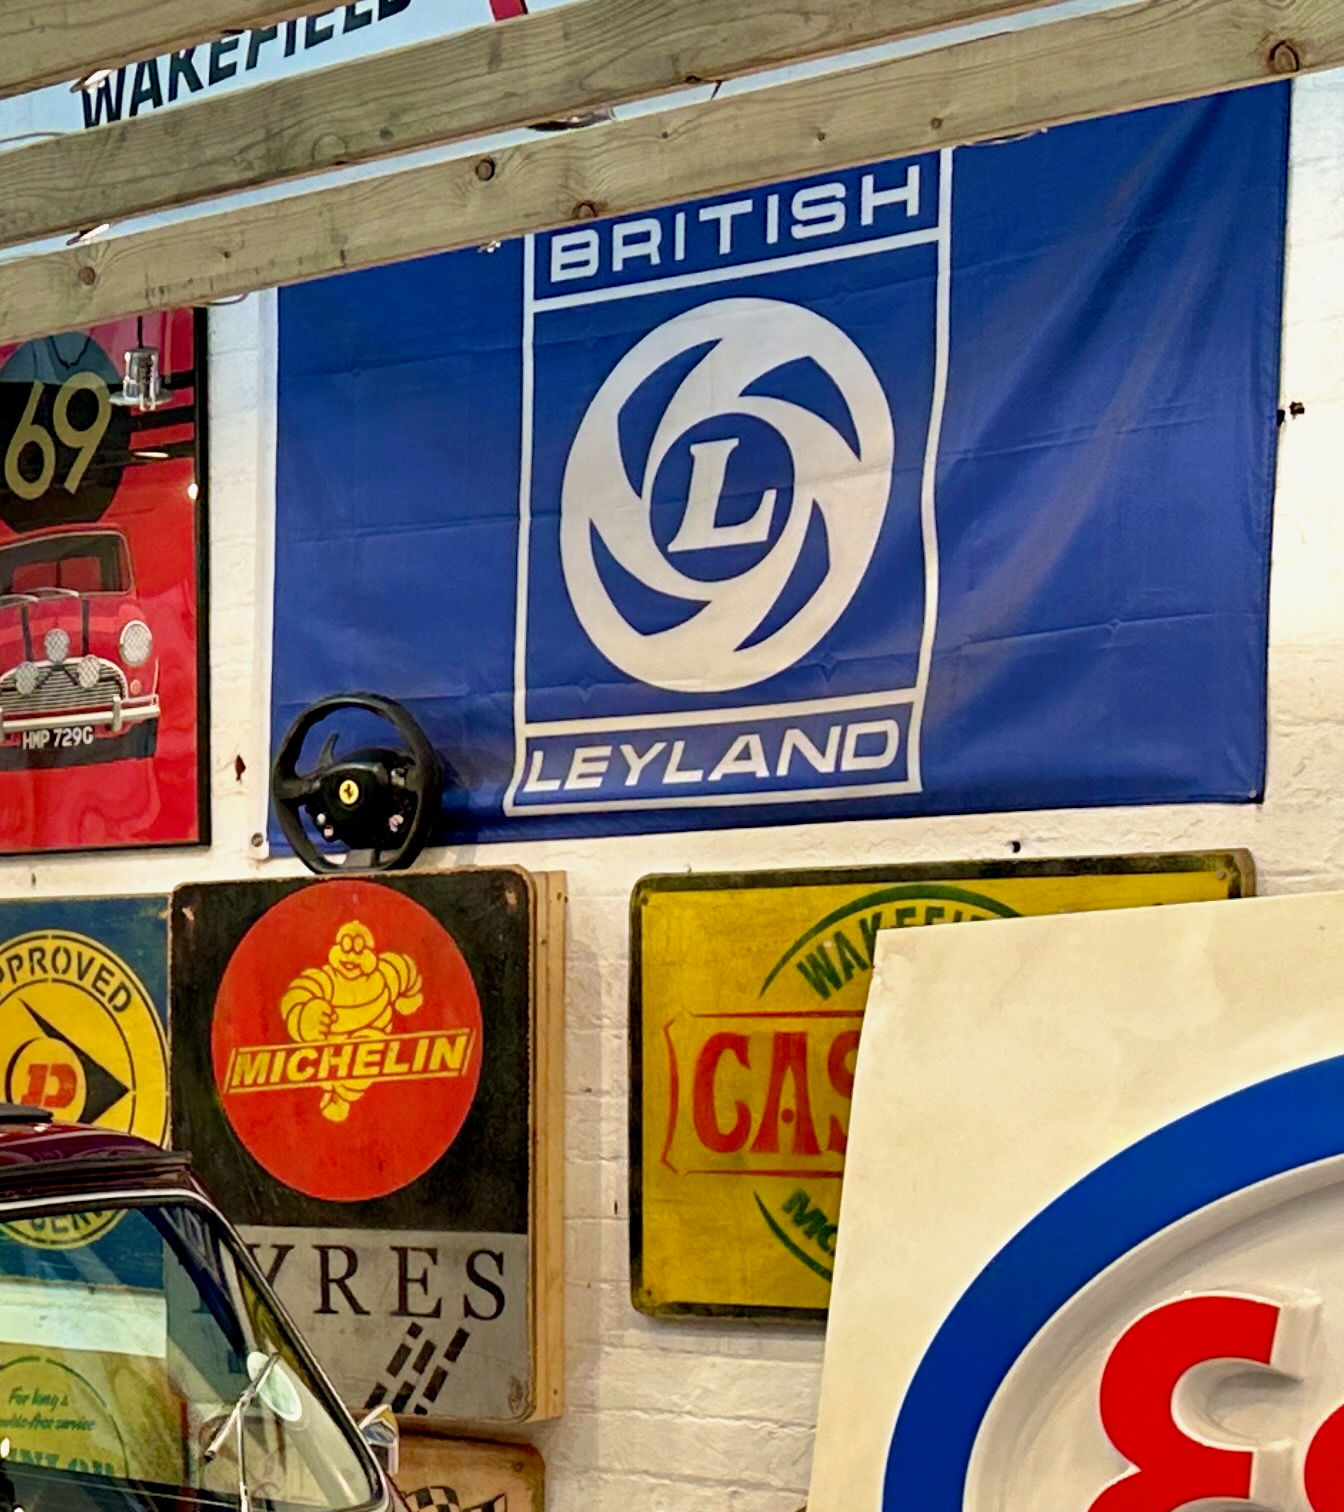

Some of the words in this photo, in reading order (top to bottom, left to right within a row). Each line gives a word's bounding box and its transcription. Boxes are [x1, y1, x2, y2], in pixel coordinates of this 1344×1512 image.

[550, 164, 920, 282] BRITISH
[5, 372, 112, 499] 69
[667, 437, 777, 554] L
[22, 729, 51, 750] HMP
[523, 719, 900, 795] LEYLAND
[233, 1034, 468, 1090] MICHELIN
[9, 1386, 35, 1406] For
[35, 1386, 60, 1412] long
[54, 1417, 97, 1432] service
